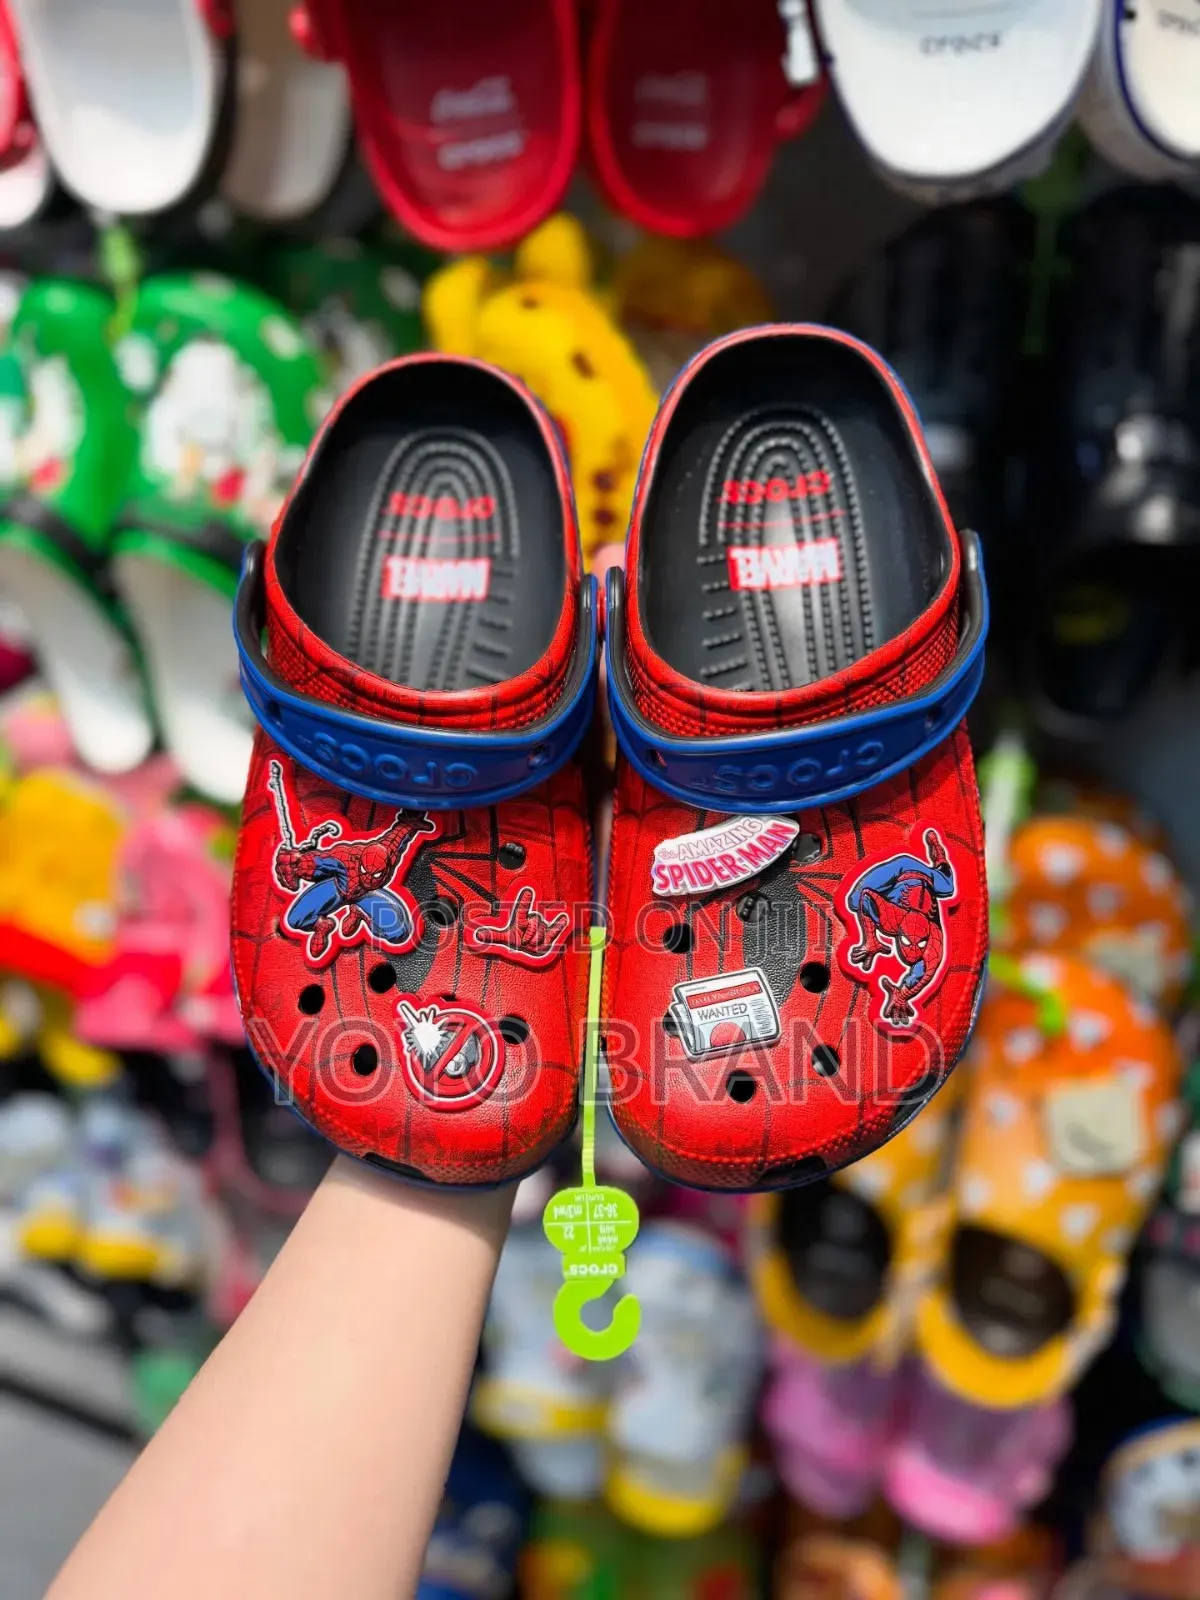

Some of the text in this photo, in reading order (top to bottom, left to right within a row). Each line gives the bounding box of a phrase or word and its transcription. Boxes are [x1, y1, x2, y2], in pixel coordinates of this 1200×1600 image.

[383, 556, 491, 602] MARVEL
[730, 541, 840, 590] MARVEL
[314, 731, 477, 788] crocs
[714, 740, 884, 791] crocs
[654, 822, 798, 891] SPIDER-MAN
[678, 817, 764, 861] AMAZING
[697, 1003, 748, 1021] WANTED
[569, 1263, 619, 1277] crocs
